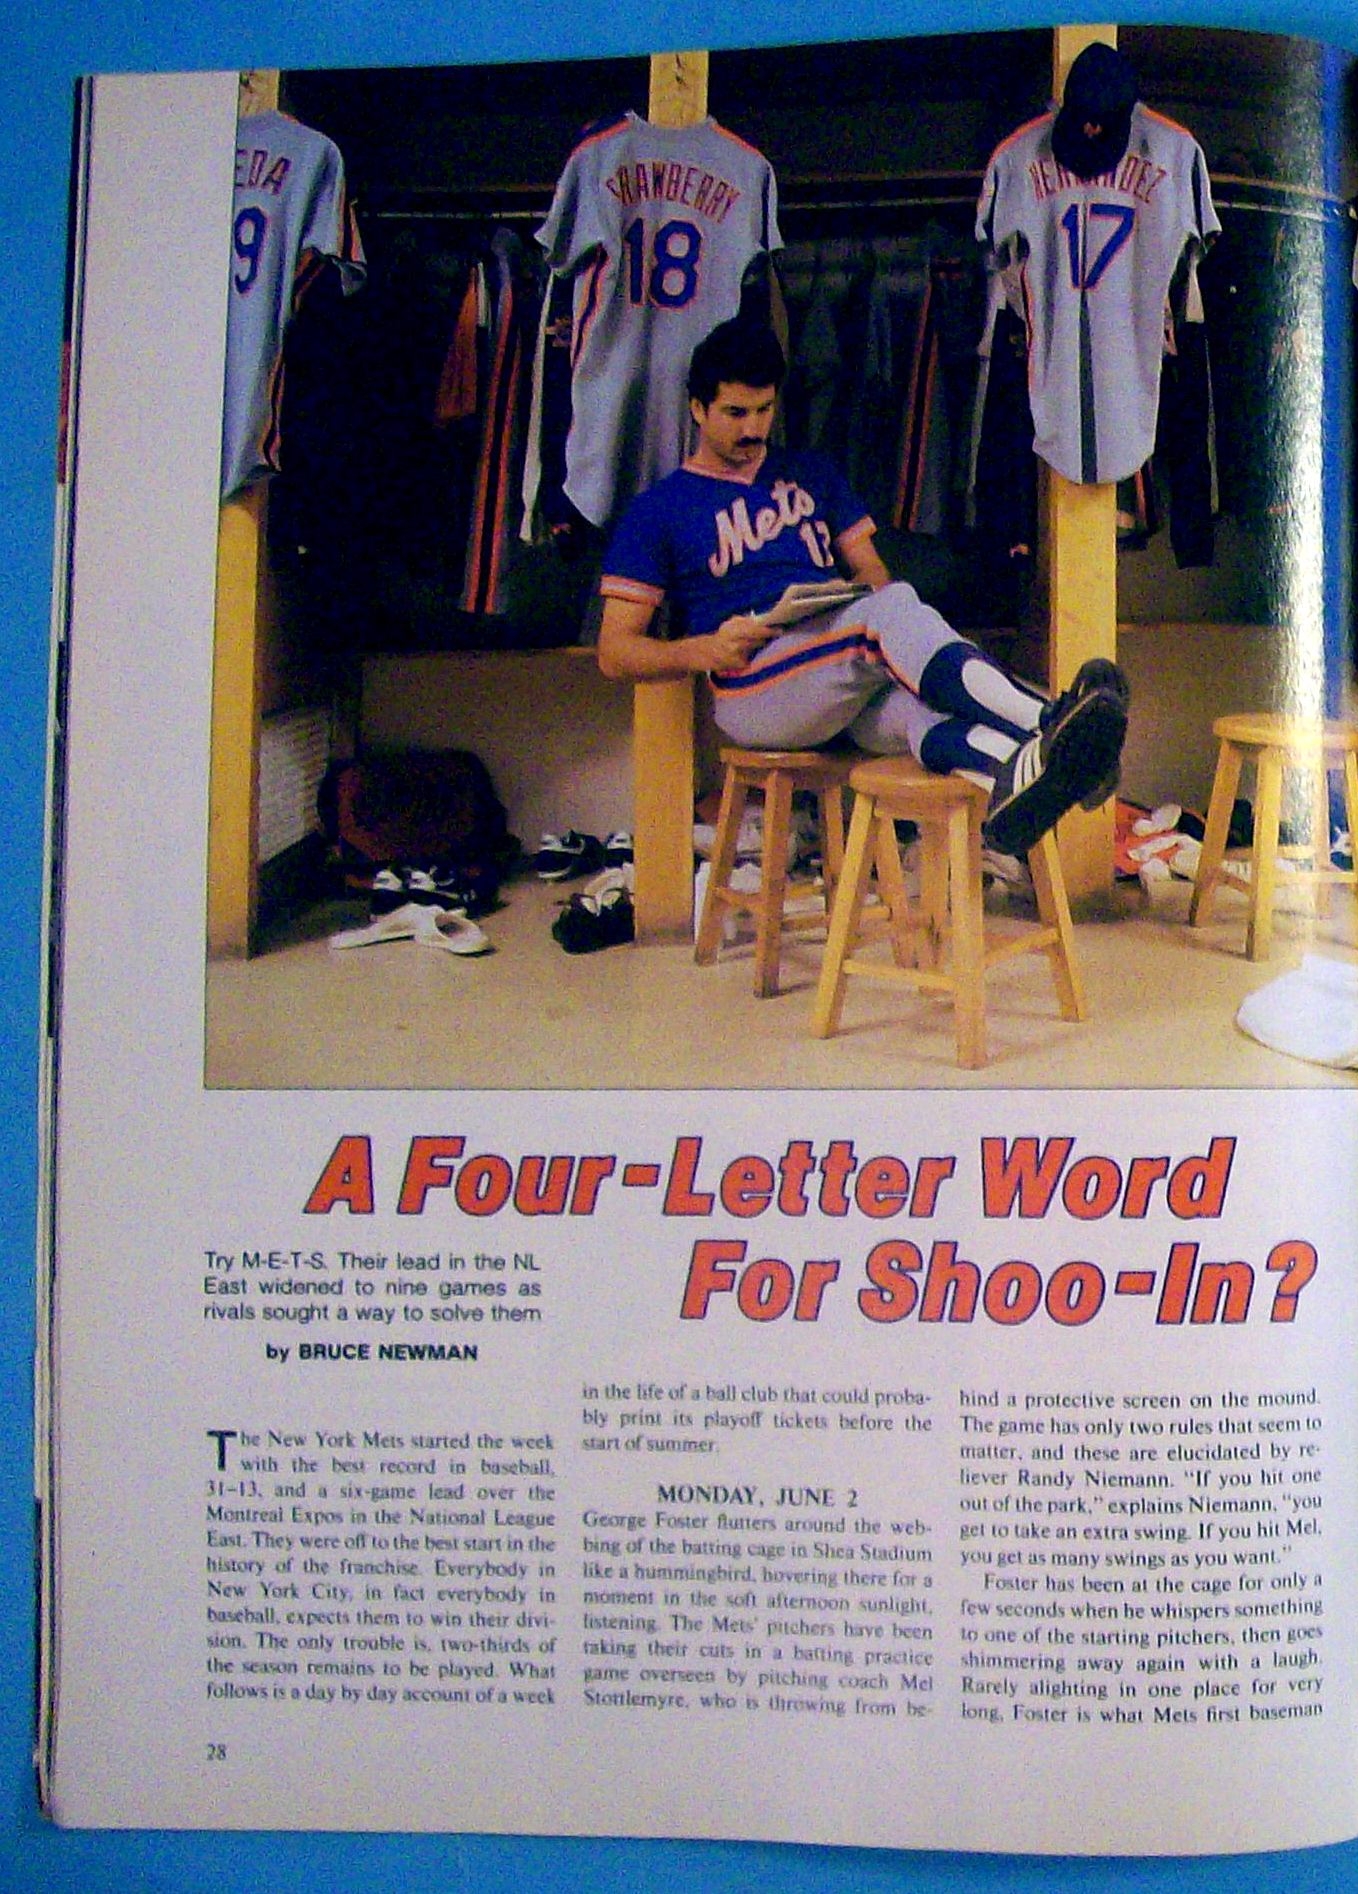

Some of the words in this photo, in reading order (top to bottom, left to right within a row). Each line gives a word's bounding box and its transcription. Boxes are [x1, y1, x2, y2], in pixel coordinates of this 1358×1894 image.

[234, 206, 268, 294] 9
[1059, 202, 1139, 289] 17
[624, 217, 704, 309] 18
[708, 479, 815, 577] Mets
[303, 1134, 375, 1215] A
[397, 1134, 956, 1218] Four-Letter
[980, 1136, 1237, 1220] Word
[204, 1251, 234, 1273] Try
[338, 1251, 388, 1270] Their
[397, 1252, 440, 1270] lead
[449, 1253, 465, 1270] in
[474, 1254, 506, 1270] the
[514, 1253, 541, 1271] NL
[204, 1276, 247, 1294] East
[259, 1278, 343, 1295] widened
[355, 1279, 375, 1295] to
[386, 1278, 427, 1296] nine
[439, 1282, 506, 1300] games
[518, 1282, 541, 1296] as
[680, 1239, 841, 1322] For
[857, 1239, 1319, 1325] Shoo-In?
[204, 1302, 255, 1321] rivals
[263, 1303, 328, 1325] sought
[337, 1306, 348, 1321] a
[356, 1307, 395, 1326] way
[403, 1305, 423, 1322] to
[431, 1303, 484, 1322] solve
[491, 1304, 541, 1322] them
[266, 1343, 289, 1363] by
[299, 1343, 370, 1360] BRUCE
[379, 1344, 478, 1361] NEWMAN
[583, 1408, 607, 1429] bly
[620, 1409, 661, 1428] print
[674, 1410, 693, 1426] its
[704, 1410, 763, 1431] playoff
[774, 1411, 828, 1429] tickets
[840, 1413, 893, 1431] before
[905, 1414, 932, 1431] the
[268, 1430, 306, 1448] New
[315, 1430, 355, 1448] York
[363, 1430, 404, 1448] Mets
[411, 1432, 470, 1450] started
[477, 1433, 503, 1449] the
[511, 1433, 554, 1450] week
[960, 1469, 1006, 1485] liever
[1018, 1468, 1074, 1490] Randy
[1220, 1473, 1251, 1490] you
[1261, 1468, 1282, 1486] hit
[1292, 1470, 1321, 1483] one
[275, 1481, 306, 1498] and
[318, 1486, 327, 1499] a
[340, 1482, 416, 1502] six-game
[429, 1482, 464, 1500] lead
[477, 1488, 514, 1501] over
[529, 1484, 555, 1501] the
[776, 1487, 836, 1507] JUNE
[848, 1489, 857, 1508] 2
[206, 1504, 283, 1523] Montreal
[292, 1505, 343, 1526] Expos
[351, 1508, 366, 1524] in
[375, 1509, 401, 1525] the
[410, 1507, 485, 1525] National
[494, 1508, 555, 1530] League
[960, 1498, 987, 1511] out
[993, 1495, 1010, 1512] of
[1016, 1496, 1042, 1512] the
[1108, 1497, 1183, 1517] explains
[961, 1651, 1065, 1676] shimmering
[1078, 1658, 1123, 1674] away
[1137, 1654, 1184, 1675] again
[1199, 1653, 1238, 1671] with
[1251, 1657, 1260, 1669] a
